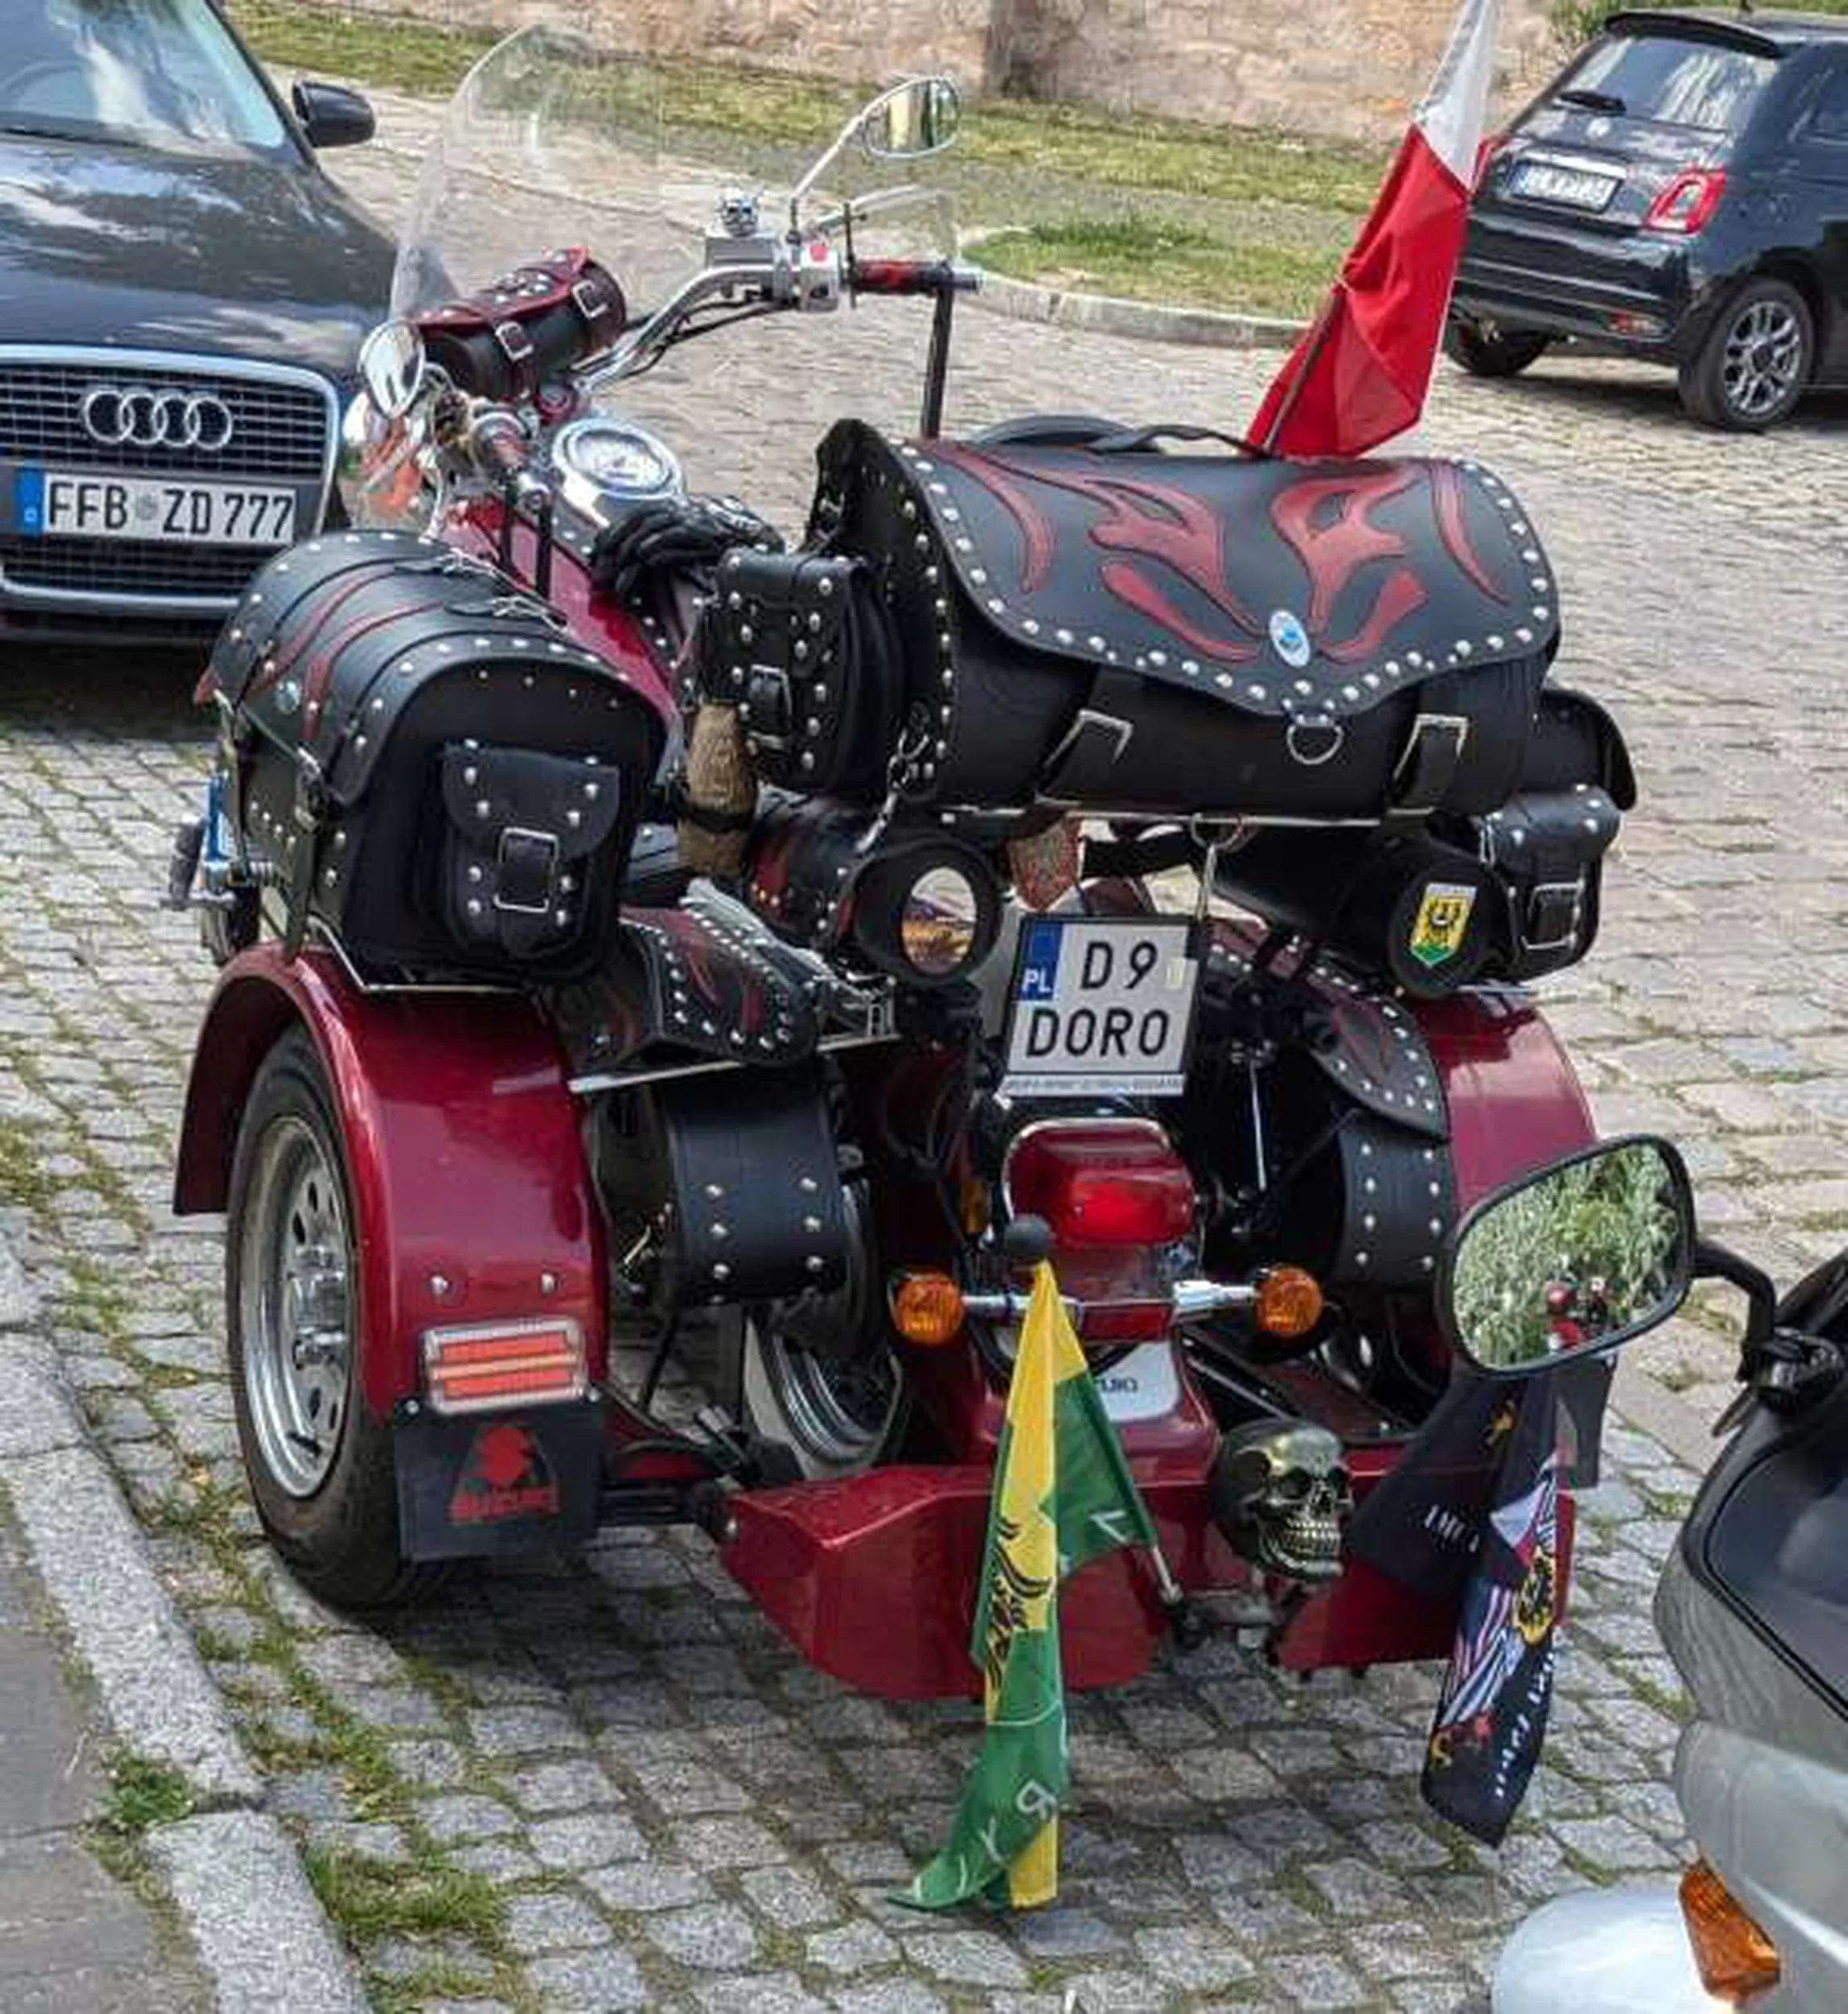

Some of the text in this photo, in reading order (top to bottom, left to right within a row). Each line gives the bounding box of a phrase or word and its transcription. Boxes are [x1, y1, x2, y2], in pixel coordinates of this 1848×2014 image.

[49, 483, 293, 539] FFB ZD 777
[1021, 968, 1051, 993] PL
[1080, 940, 1158, 989] D9
[1026, 1007, 1169, 1057] DORO
